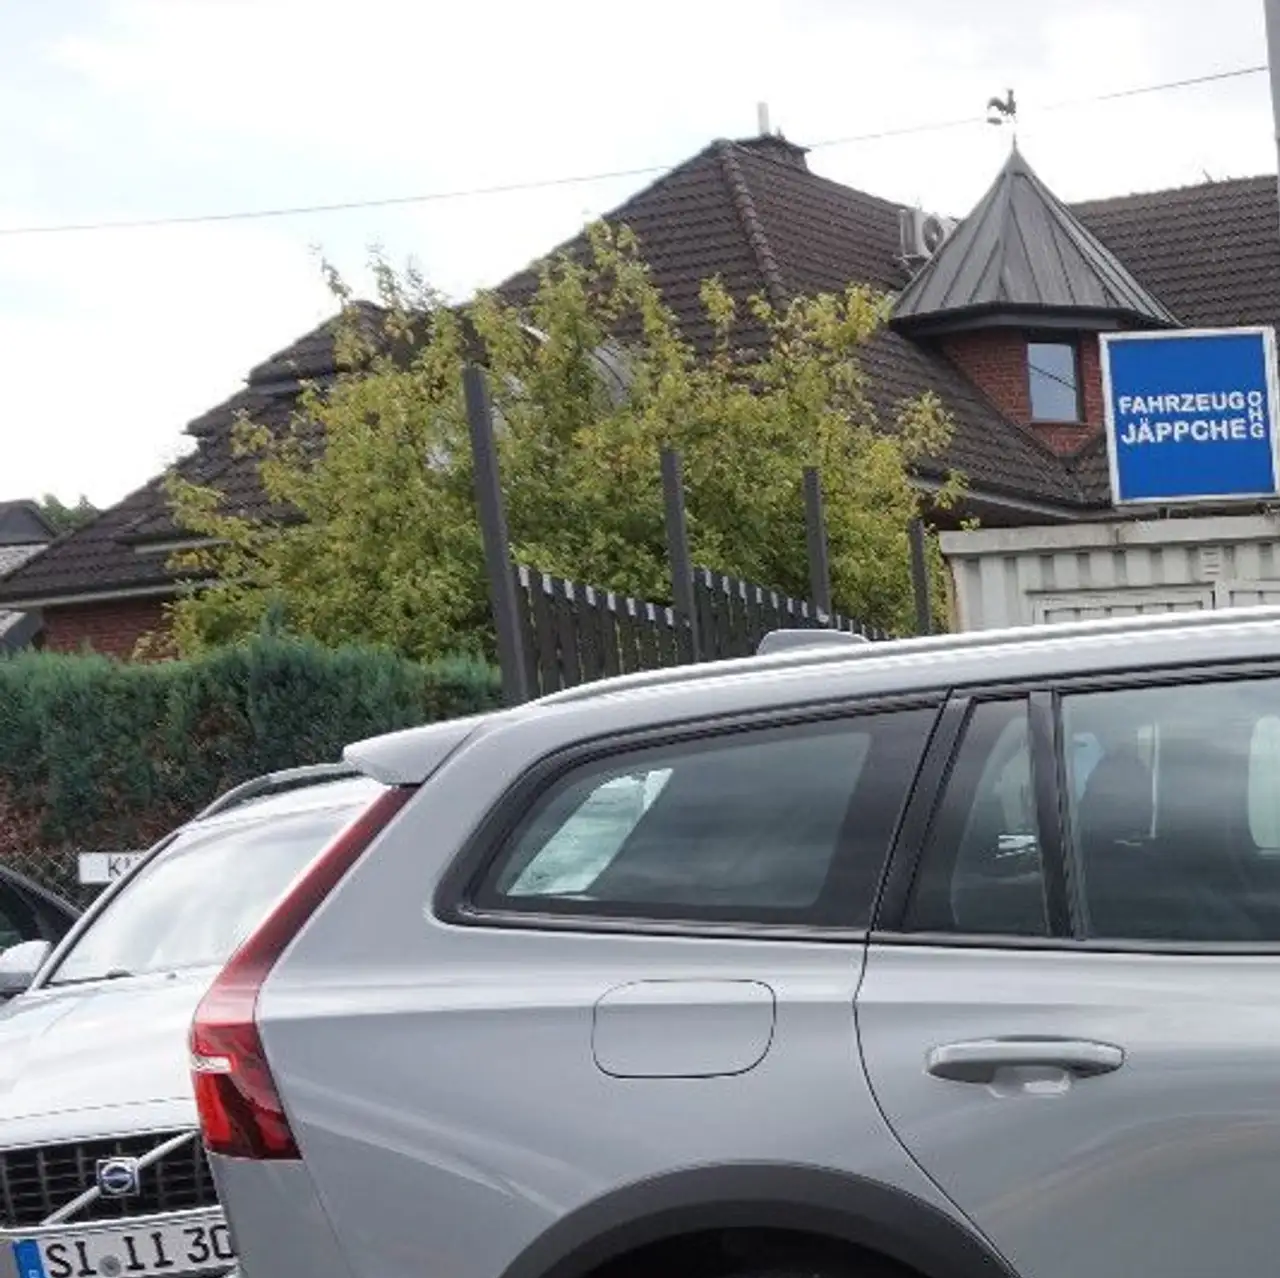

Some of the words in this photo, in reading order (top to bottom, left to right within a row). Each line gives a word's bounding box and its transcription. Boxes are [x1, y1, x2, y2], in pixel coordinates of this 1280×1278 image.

[1118, 390, 1245, 415] FAHRZEUG
[1247, 390, 1267, 439] OHG
[1121, 417, 1247, 444] JÄPPCHE
